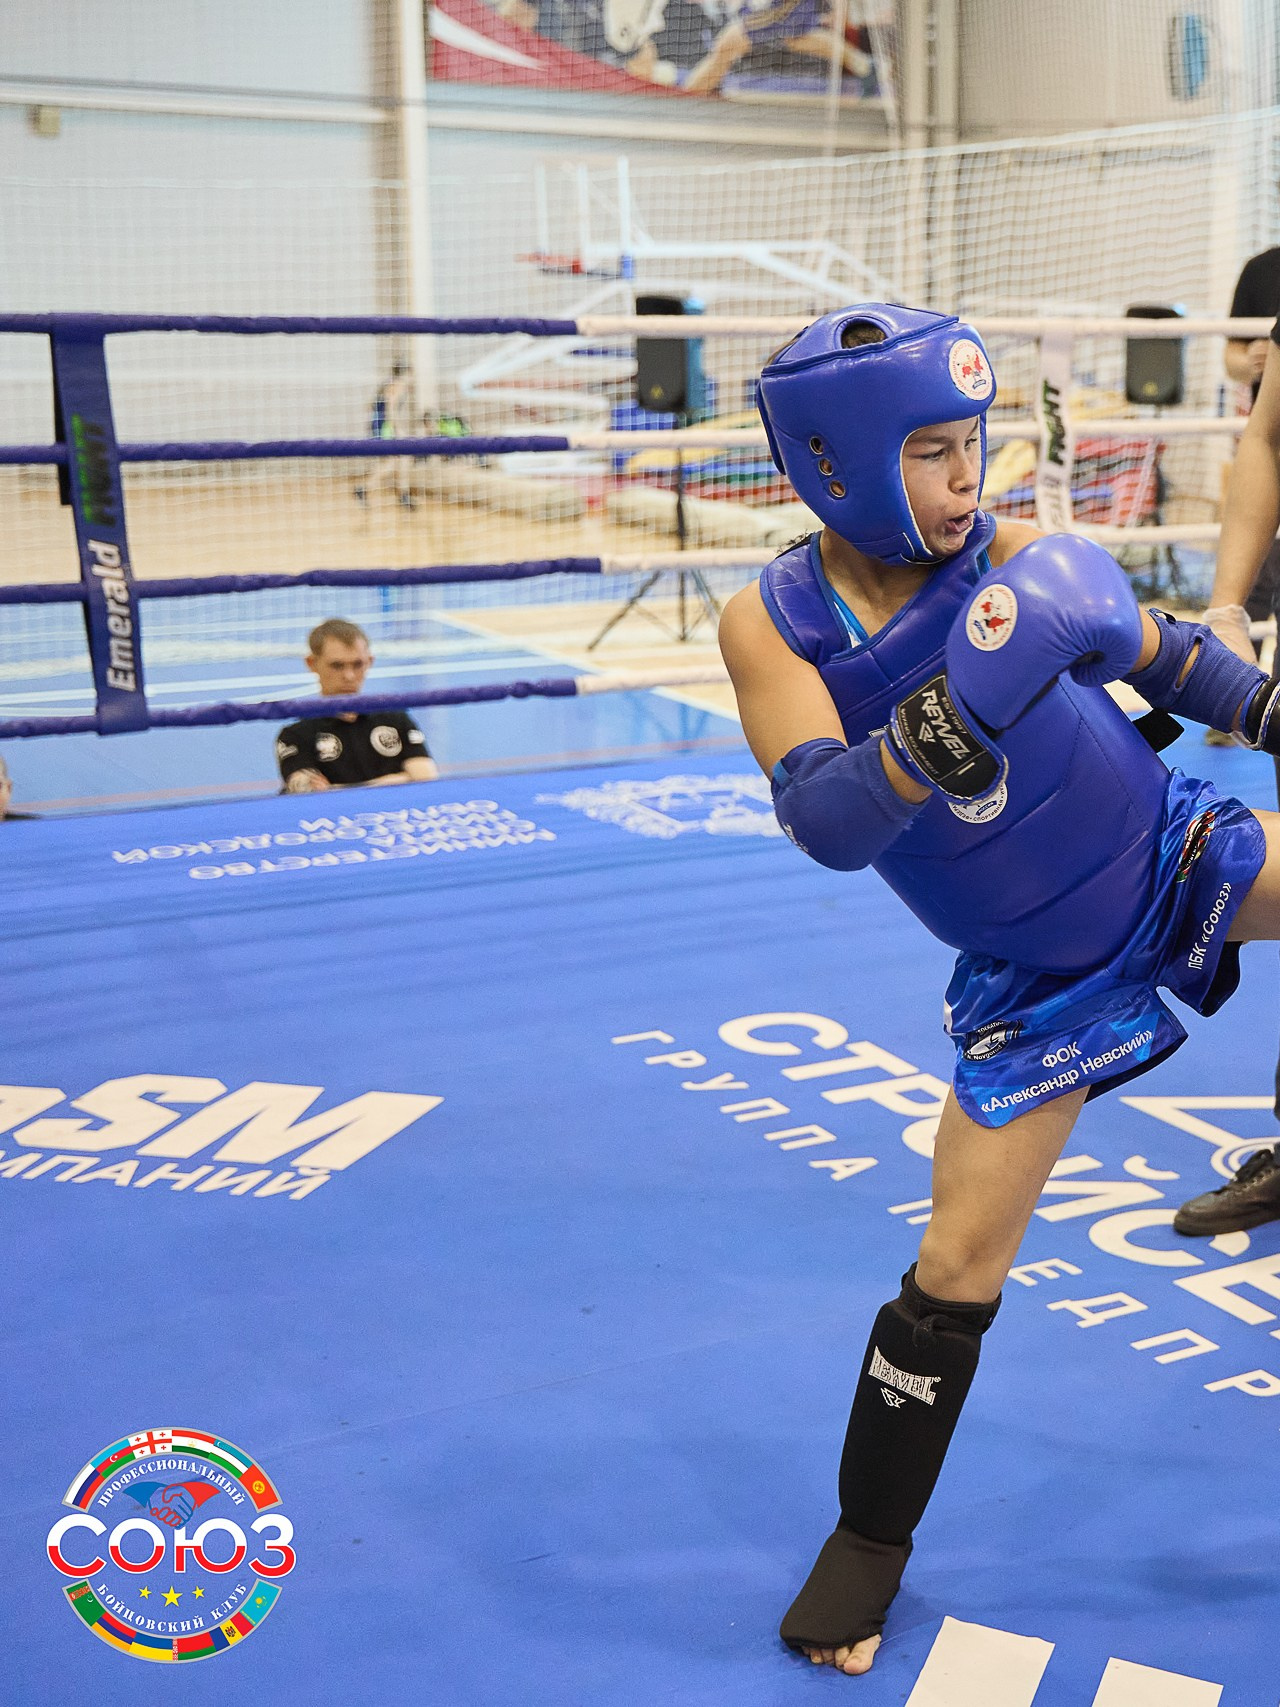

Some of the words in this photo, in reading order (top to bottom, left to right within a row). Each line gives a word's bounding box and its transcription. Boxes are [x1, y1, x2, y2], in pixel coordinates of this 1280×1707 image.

[87, 539, 137, 692] Emerald
[1188, 942, 1207, 970] ПБК
[1201, 882, 1232, 943] «Союз»
[981, 1069, 1079, 1113] «Александр
[1080, 1029, 1153, 1075] Невский»
[1042, 1041, 1083, 1068] ФОК
[0, 1073, 445, 1170] SM
[611, 1030, 879, 1182] ГРУППА
